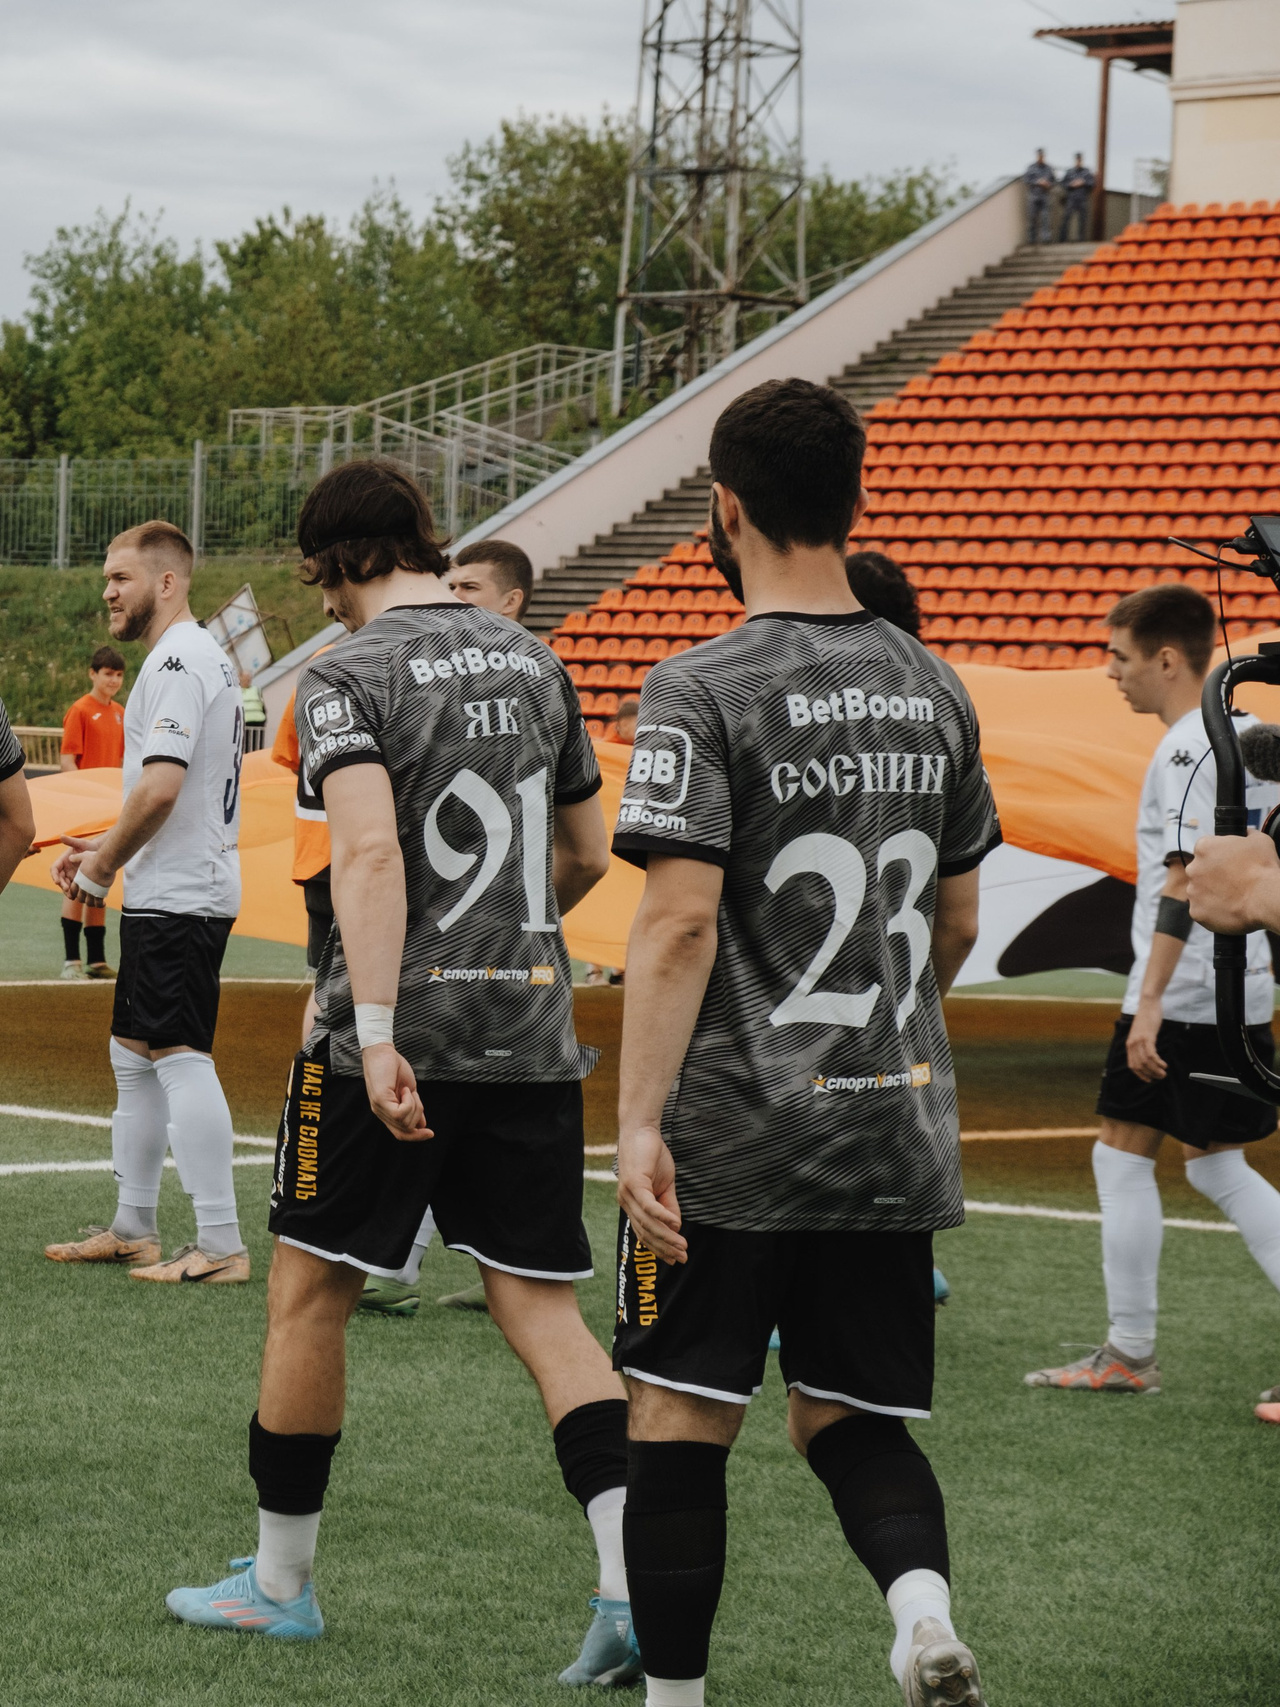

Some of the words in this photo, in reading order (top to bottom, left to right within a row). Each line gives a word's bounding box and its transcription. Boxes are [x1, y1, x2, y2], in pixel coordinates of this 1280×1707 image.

[408, 647, 541, 684] BetBoom
[312, 700, 343, 727] BB
[463, 697, 520, 739] ЯК
[786, 688, 934, 728] BetBoom
[308, 731, 376, 767] BetBoom
[630, 750, 676, 784] BB
[619, 805, 687, 831] tBoom
[424, 767, 557, 933] 91
[763, 829, 938, 1033] 23
[531, 967, 553, 983] PRO
[302, 1062, 324, 1096] НАС
[299, 1100, 322, 1122] НЕ
[295, 1124, 319, 1200] СЛОМАТЬ
